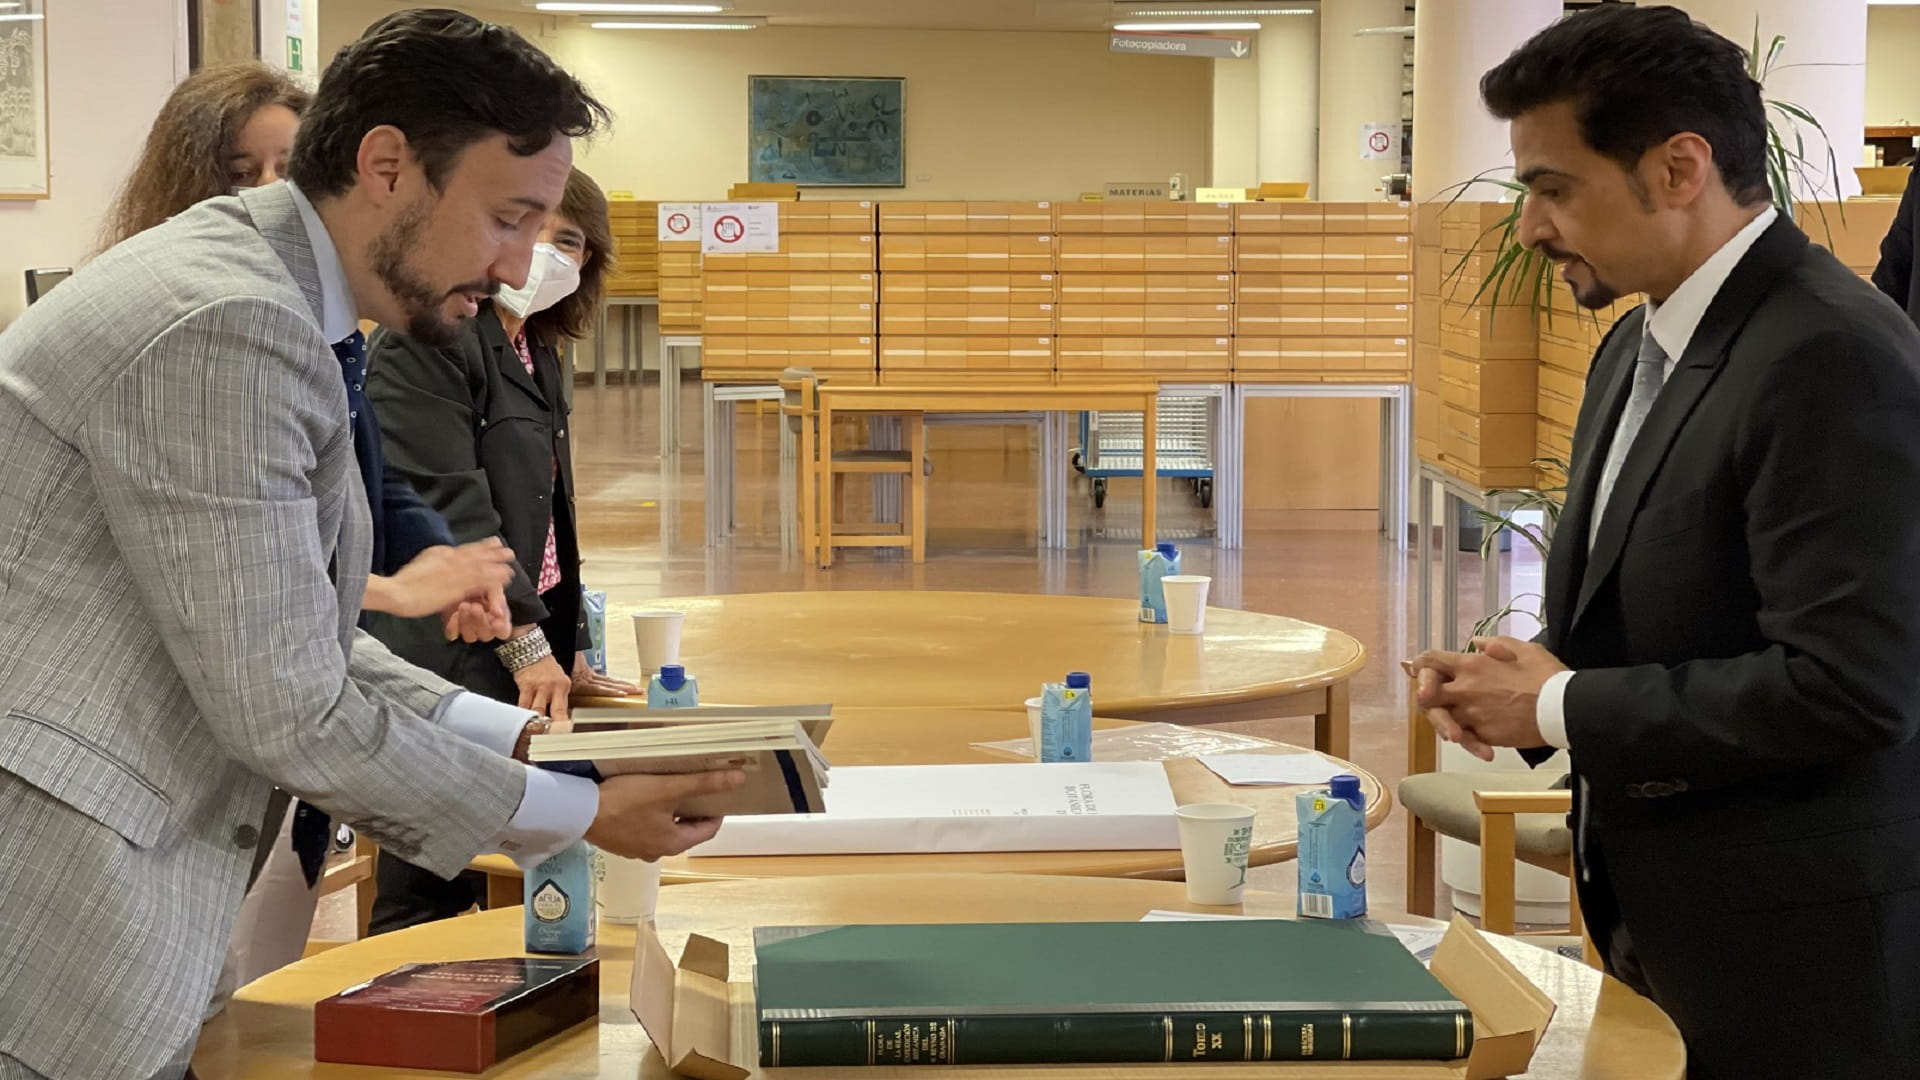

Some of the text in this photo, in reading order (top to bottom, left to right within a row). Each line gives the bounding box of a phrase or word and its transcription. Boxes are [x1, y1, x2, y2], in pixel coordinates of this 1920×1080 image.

[1112, 38, 1187, 52] Fotocopiadora
[1109, 188, 1162, 197] MATERIAS
[1193, 1022, 1206, 1058] Tomo
[1211, 1032, 1222, 1050] XX
